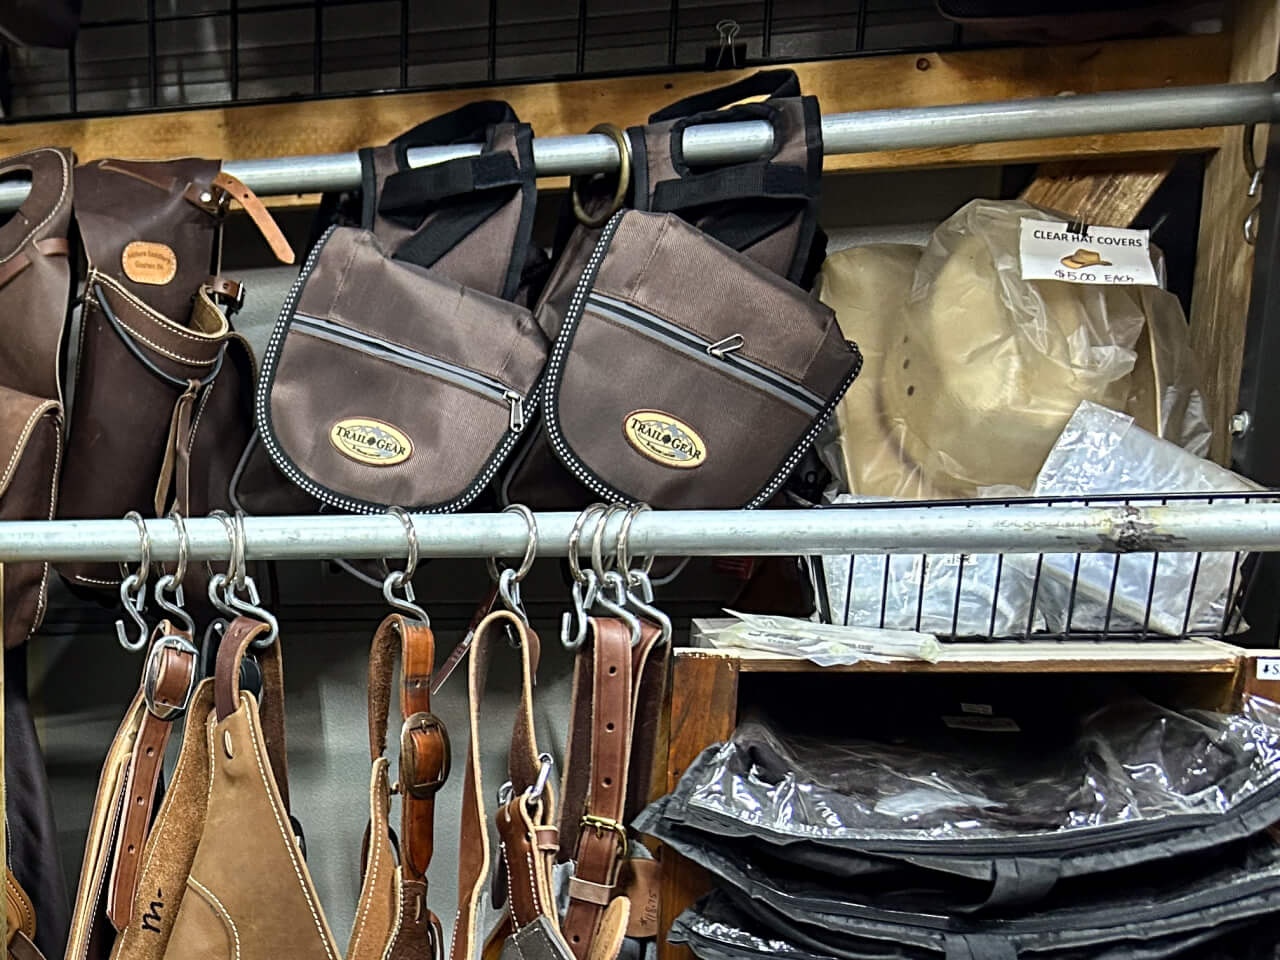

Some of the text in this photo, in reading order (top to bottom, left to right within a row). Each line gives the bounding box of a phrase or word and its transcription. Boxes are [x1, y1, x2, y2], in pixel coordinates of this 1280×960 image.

[1033, 230, 1142, 247] CLEAR HAT COVERS
[336, 426, 368, 443] TRAIL
[376, 439, 406, 455] GEAR
[631, 418, 662, 441] TRAIL
[671, 438, 701, 459] GEAR
